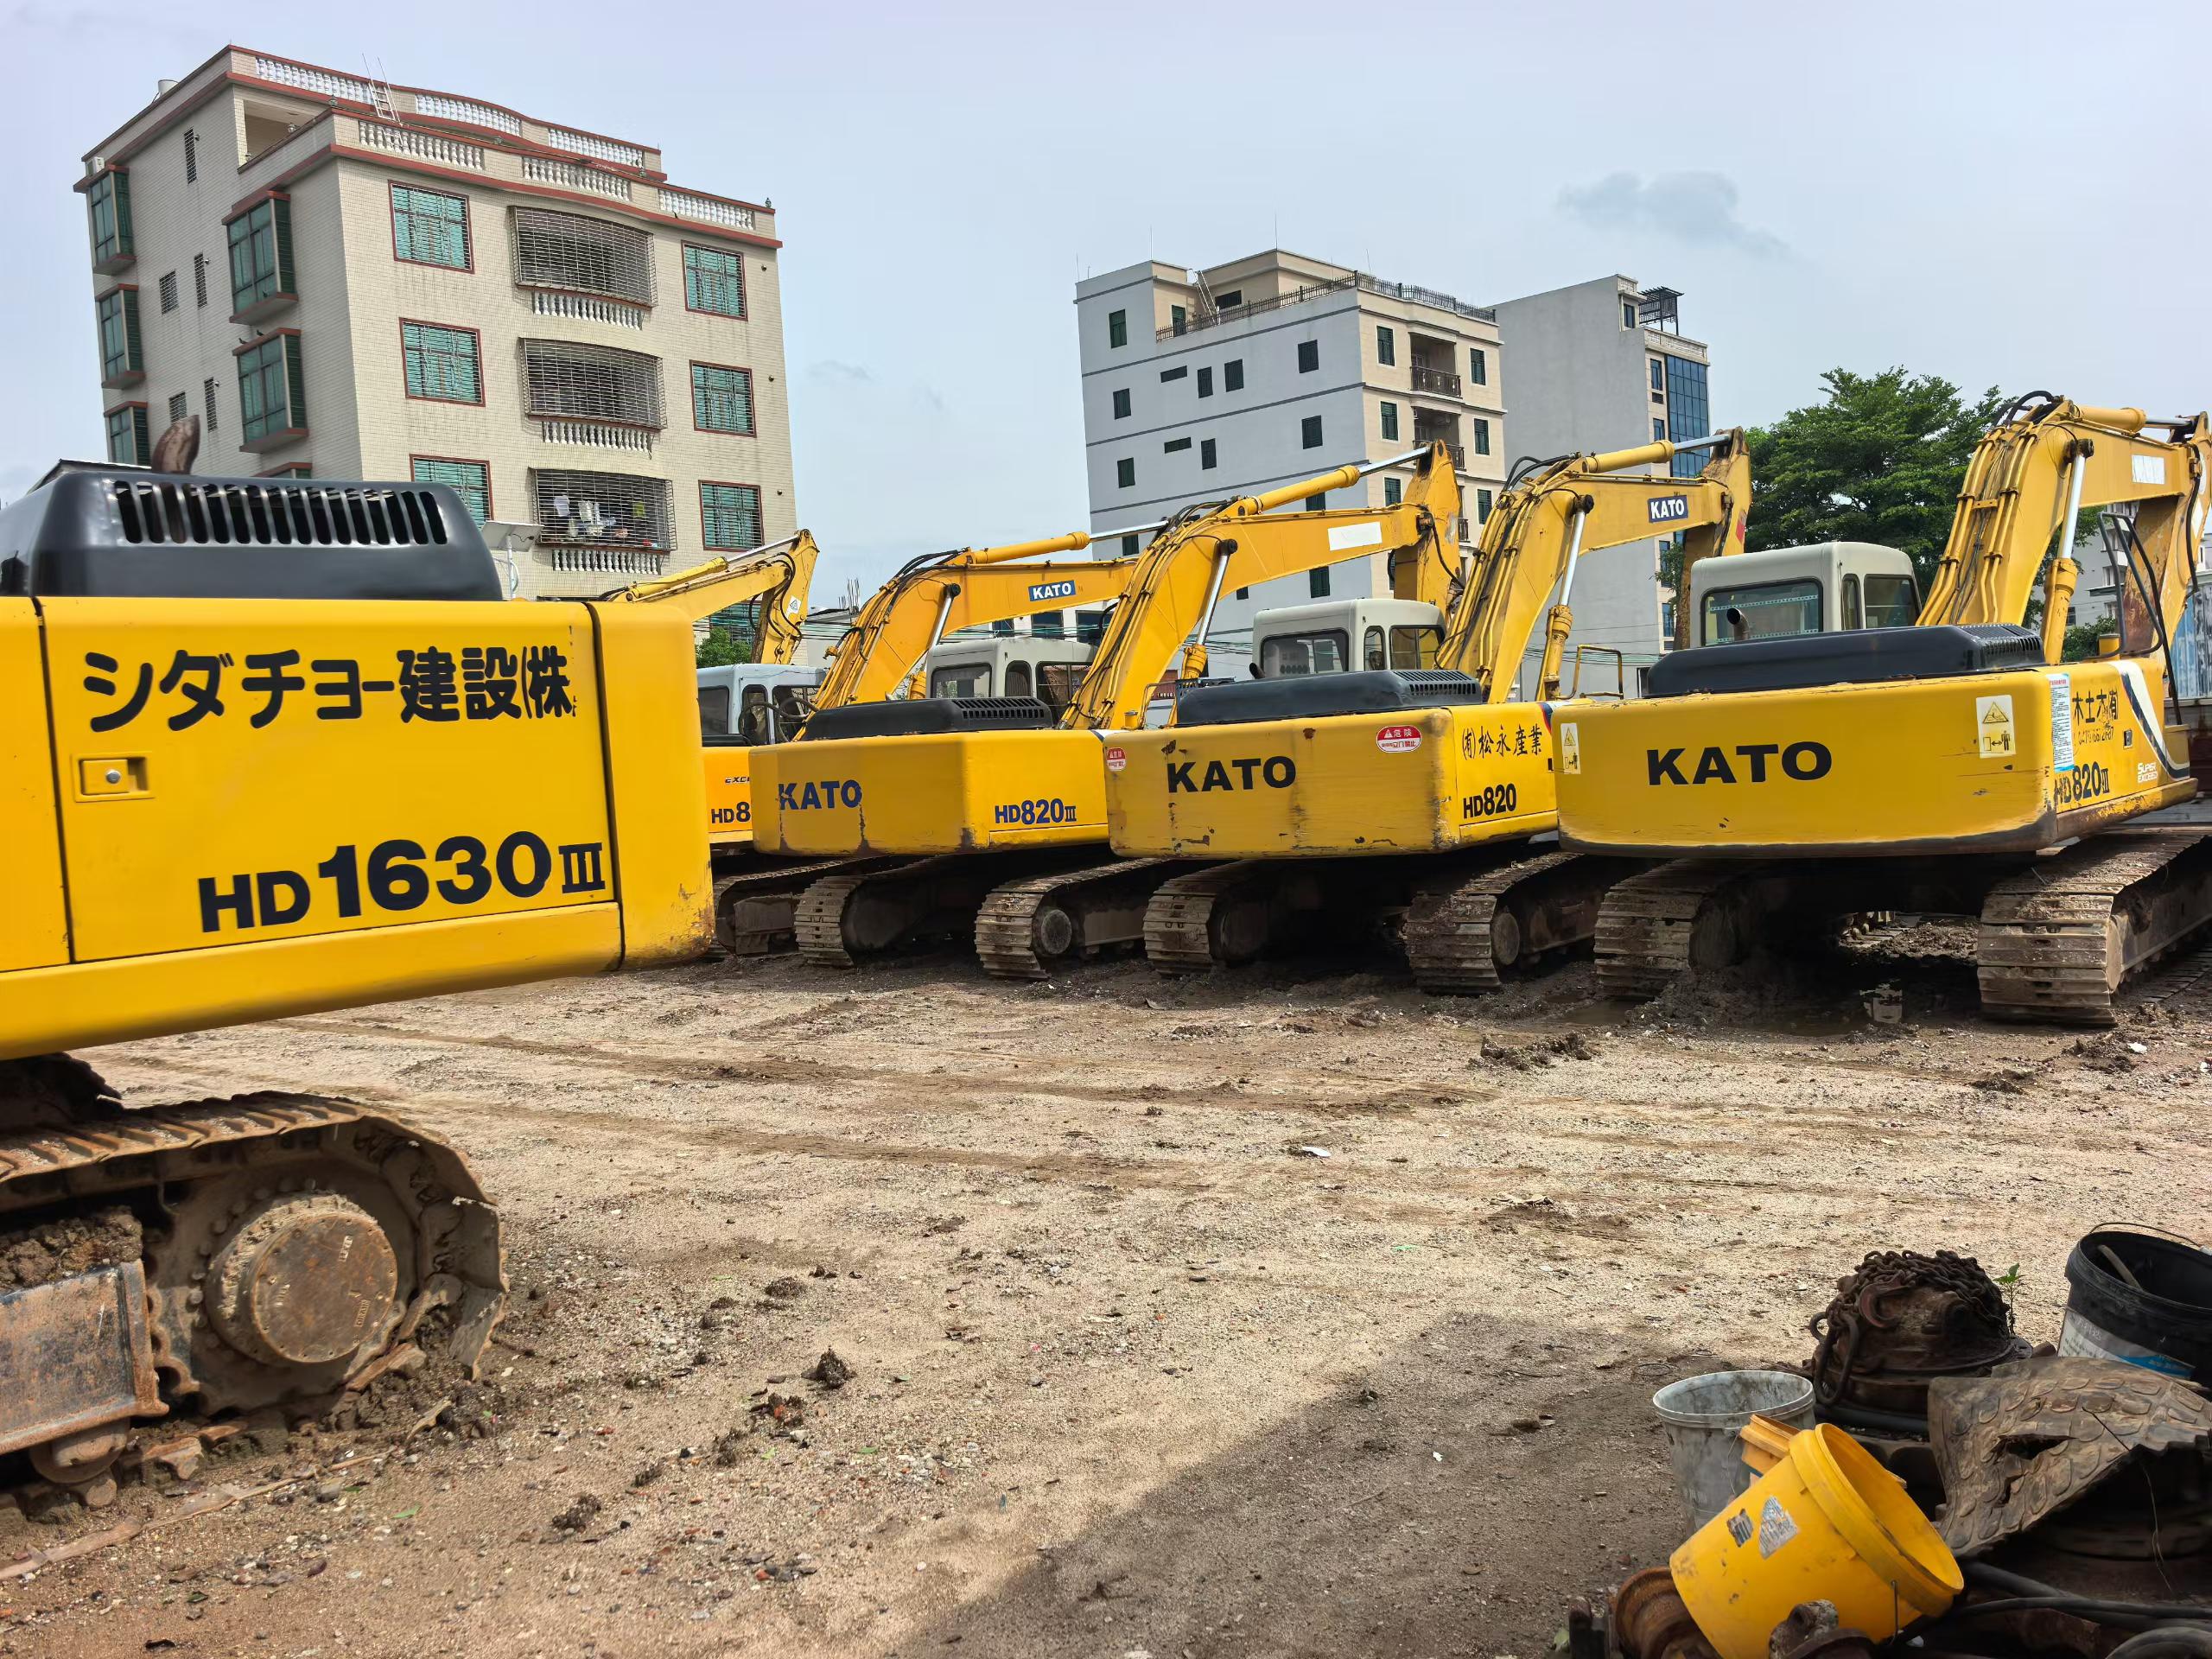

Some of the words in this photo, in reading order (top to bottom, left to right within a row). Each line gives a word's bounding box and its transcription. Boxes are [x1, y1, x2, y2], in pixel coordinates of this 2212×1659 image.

[1650, 499, 1685, 519] KATO
[1033, 582, 1072, 600] KATO
[1167, 756, 1296, 793] KATO
[1646, 741, 1833, 786] KATO
[778, 779, 862, 810] KATO
[1463, 783, 1516, 819] HD820
